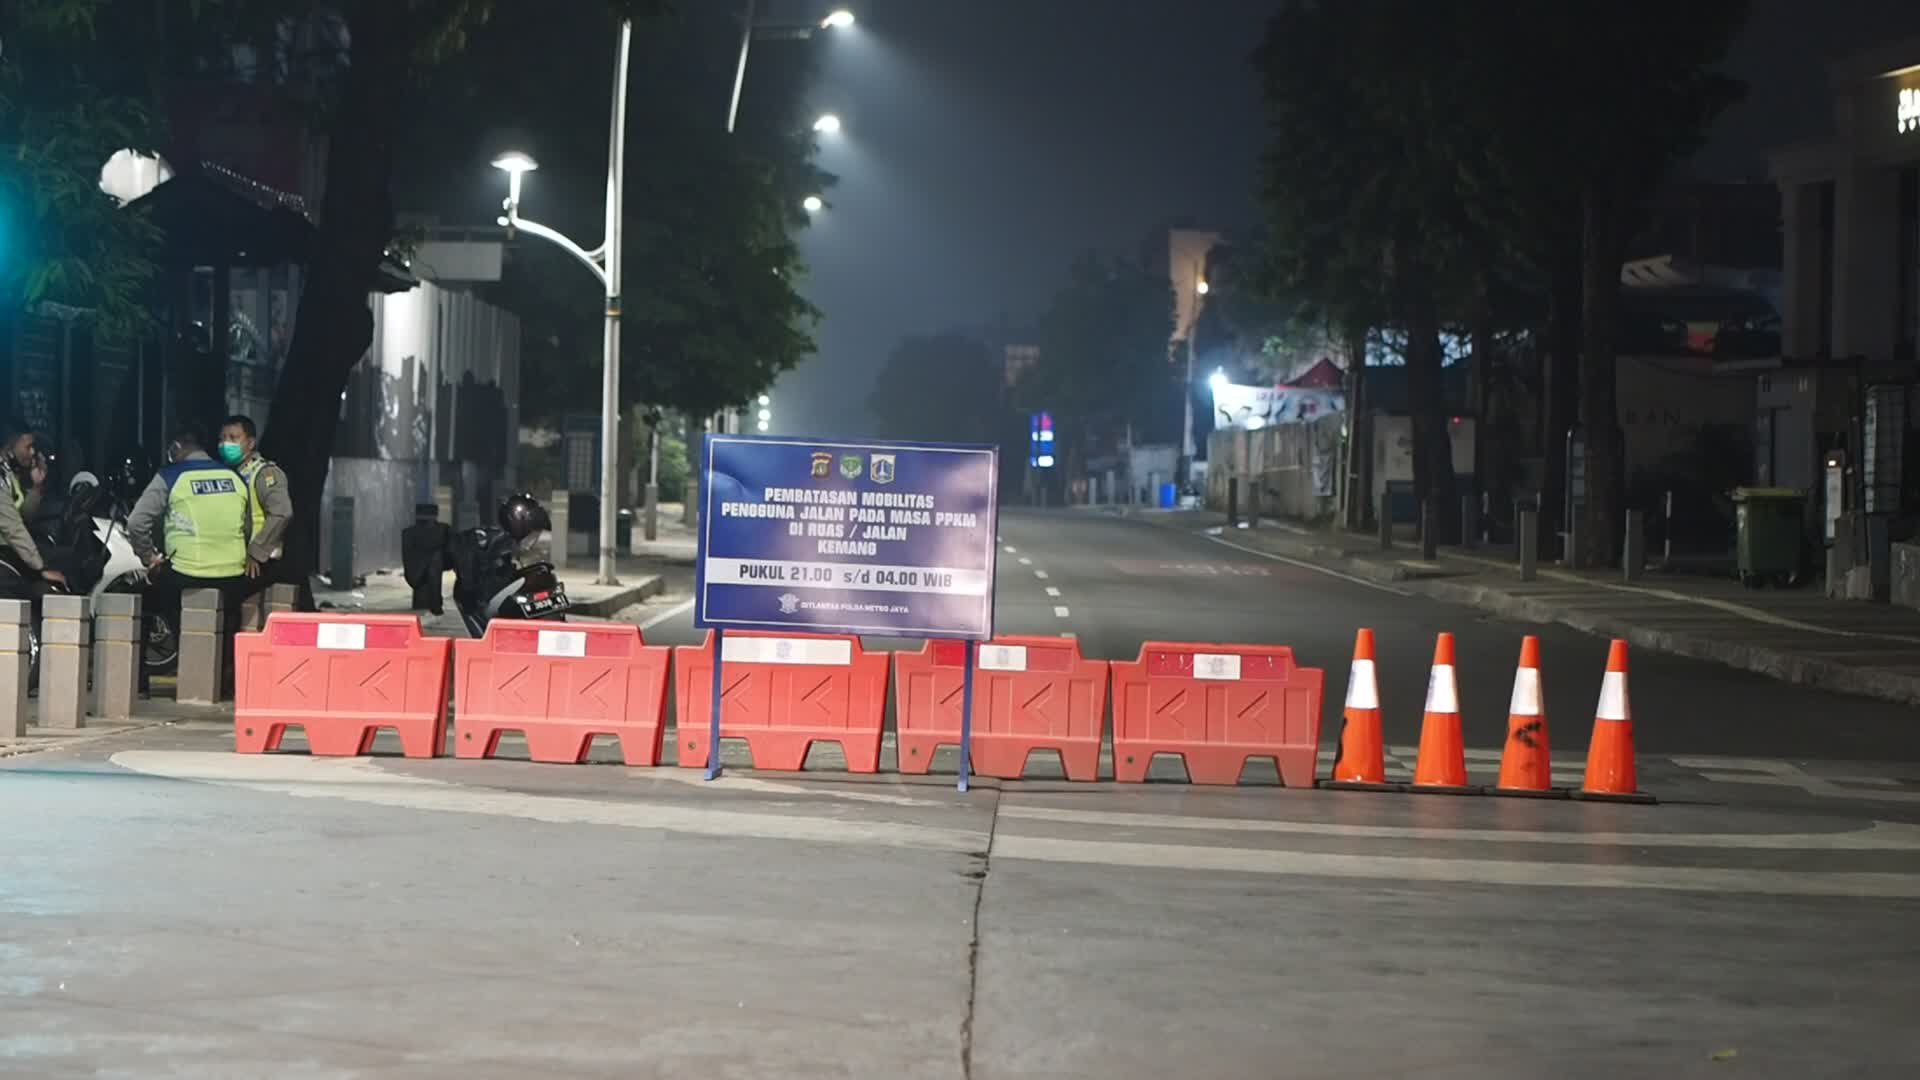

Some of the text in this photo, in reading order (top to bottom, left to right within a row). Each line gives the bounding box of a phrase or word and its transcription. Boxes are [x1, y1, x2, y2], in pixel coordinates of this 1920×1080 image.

[192, 479, 234, 495] POLISI
[764, 487, 935, 509] PEMBATASAN MOBILITAS
[721, 502, 977, 528] PENGGUNA JALAN PADA MASA PPKM
[788, 521, 803, 536] DI
[808, 523, 844, 538] RUAS
[862, 525, 907, 541] JALAN
[817, 540, 877, 556] KEMANG
[739, 564, 952, 587] PUKUL 21.00 s/d 04.00 WIB
[864, 604, 889, 613] METRO
[890, 606, 909, 614] JAYA
